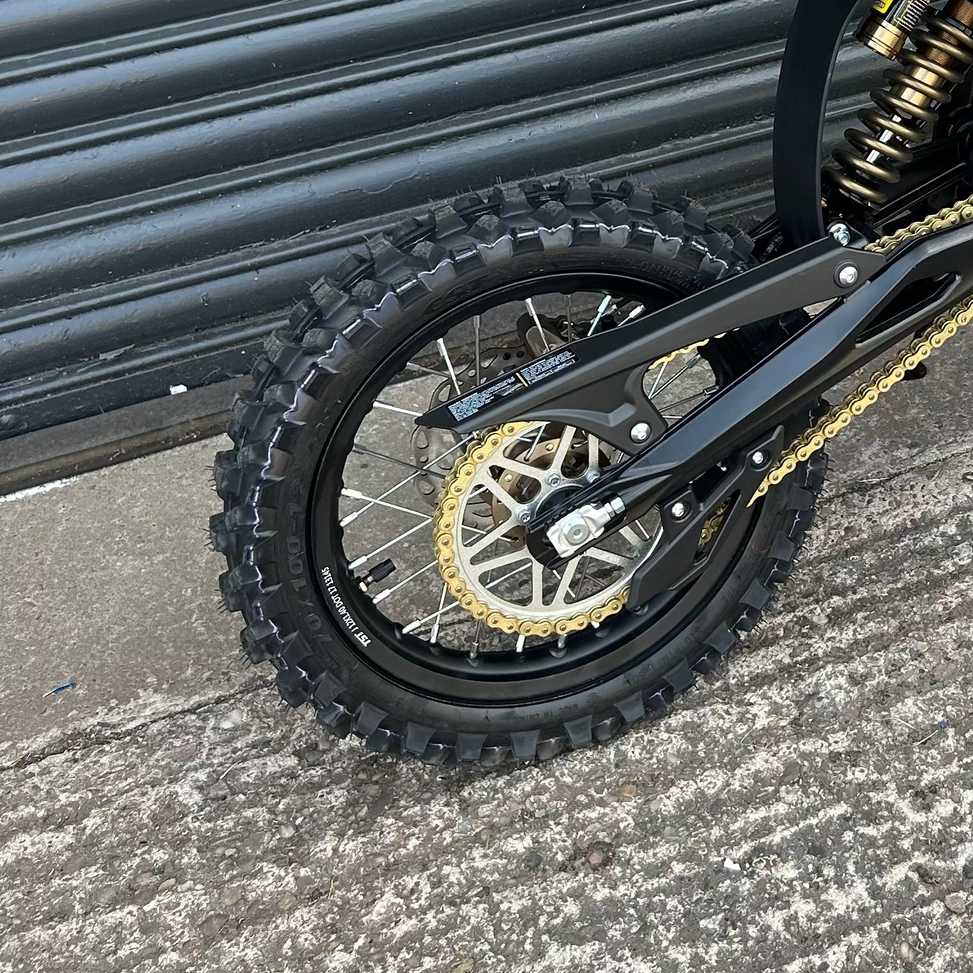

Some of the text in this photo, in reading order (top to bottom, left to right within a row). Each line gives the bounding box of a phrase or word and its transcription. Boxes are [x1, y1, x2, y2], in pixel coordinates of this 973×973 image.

[321, 566, 334, 587] 13145
[328, 586, 337, 594] 17
[331, 594, 344, 608] DOT
[354, 631, 372, 647] TST
